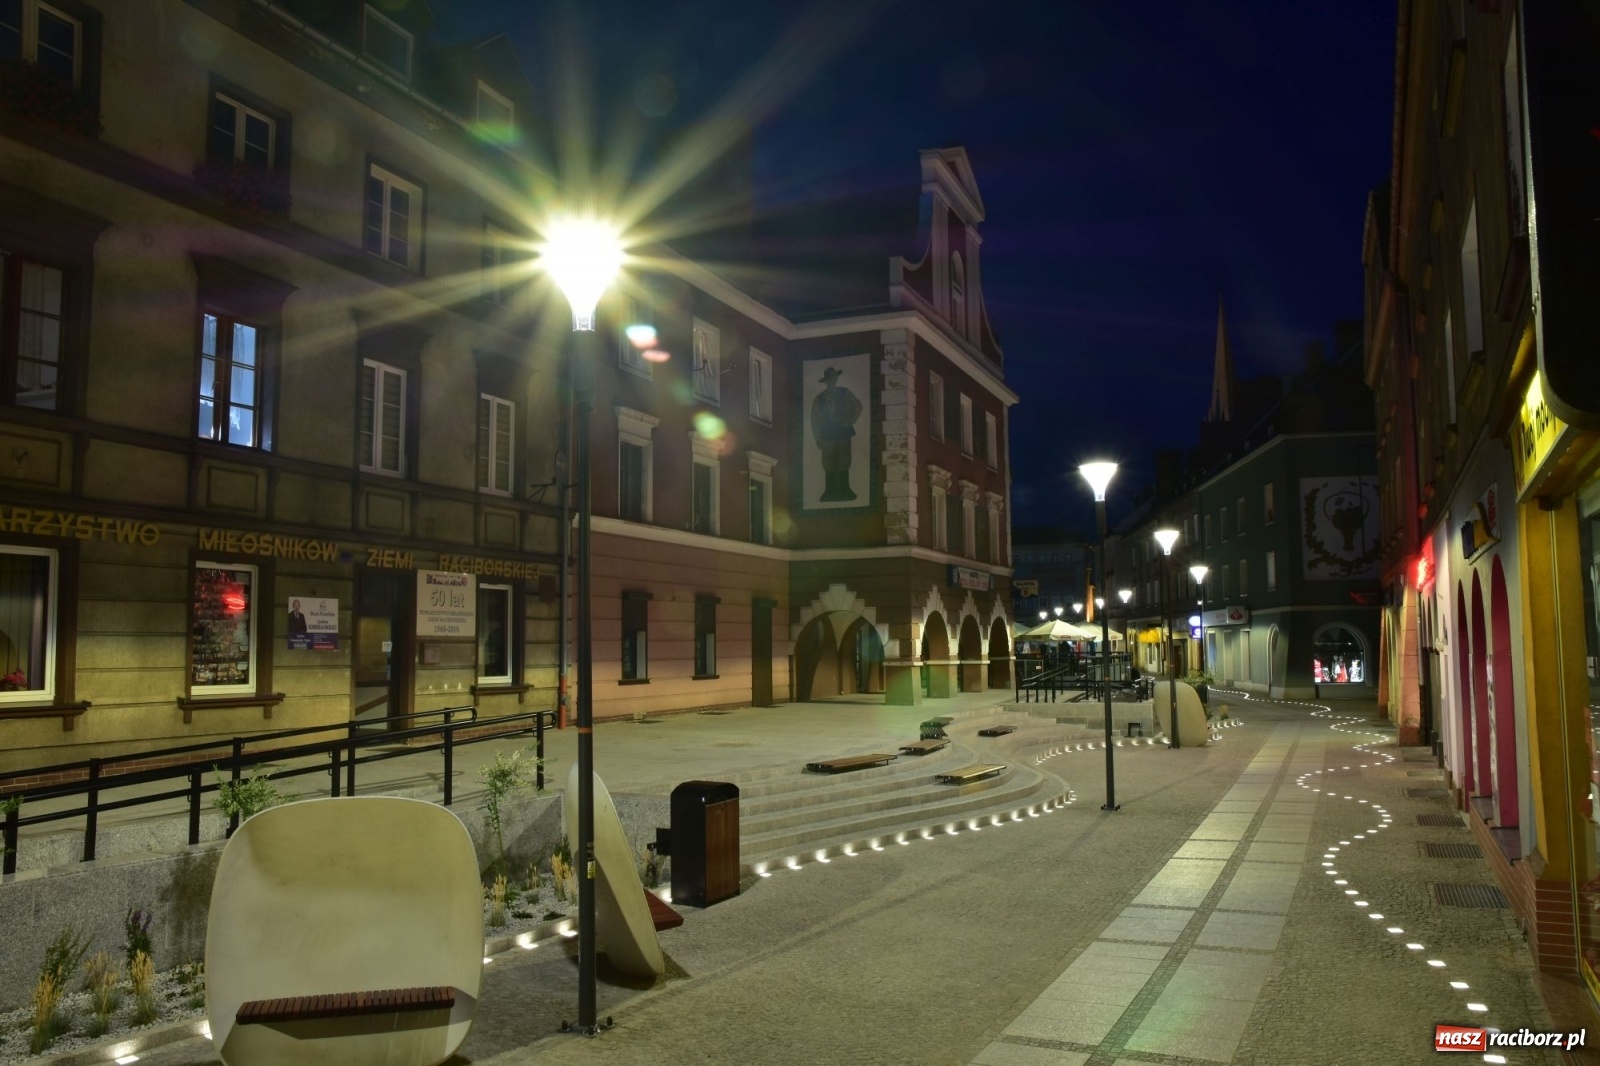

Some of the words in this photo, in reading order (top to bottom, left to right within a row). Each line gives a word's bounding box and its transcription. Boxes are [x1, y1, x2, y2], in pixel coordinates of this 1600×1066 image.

[198, 528, 340, 562] MIŁOŚNIKÓW
[367, 548, 414, 570] ZIEMI
[439, 554, 540, 580] RACIBORSKIEJ
[430, 589, 446, 607] 50
[449, 589, 465, 608] lat
